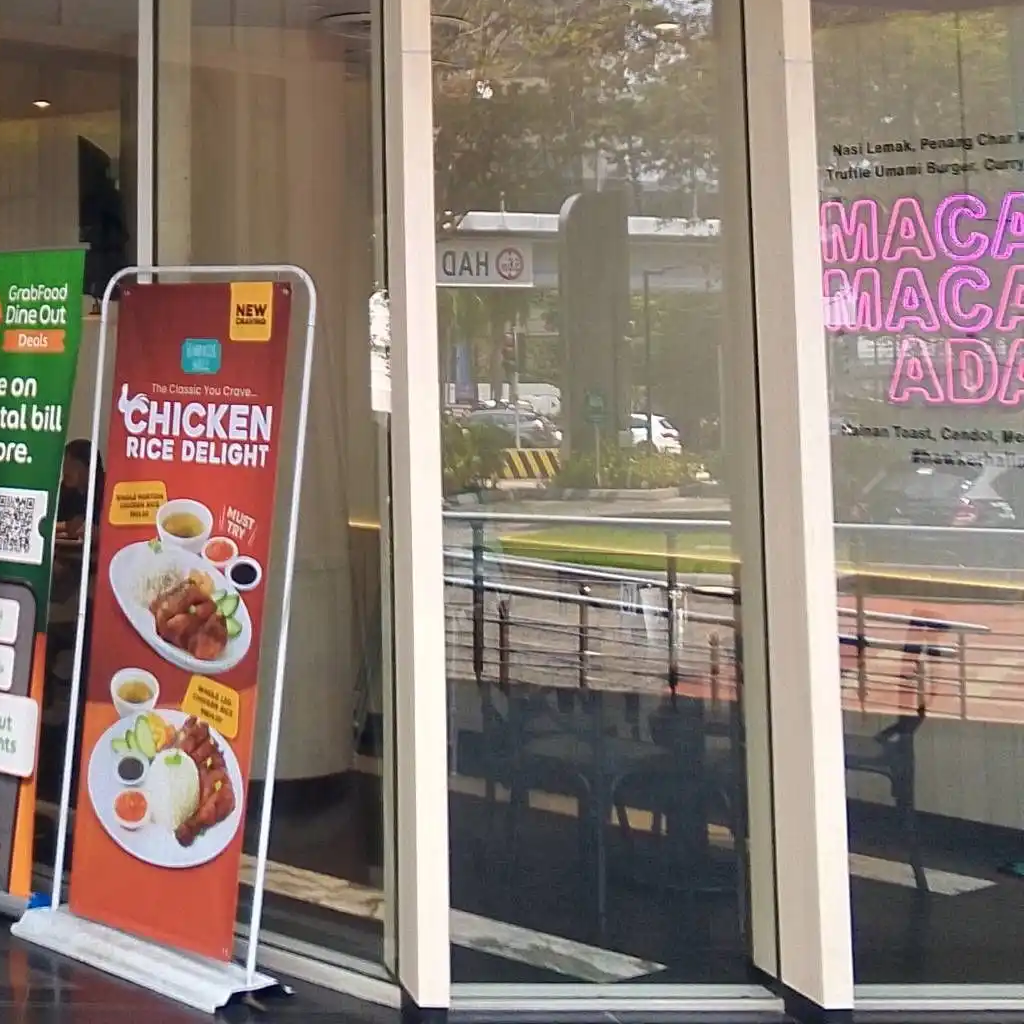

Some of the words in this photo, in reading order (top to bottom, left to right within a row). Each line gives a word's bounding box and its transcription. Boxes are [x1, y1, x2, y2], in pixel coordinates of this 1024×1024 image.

[833, 143, 864, 157] Nasi
[920, 136, 974, 151] Penang
[977, 132, 1014, 147] Char
[875, 163, 923, 178] Umami
[819, 191, 1024, 264] MACA
[8, 283, 68, 302] GrabFood
[823, 264, 1024, 332] MACA
[5, 305, 37, 325] Dine
[39, 304, 67, 325] Out
[236, 303, 268, 317] NEW
[18, 333, 48, 348] Deals
[10, 377, 37, 397] on
[152, 383, 167, 394] The
[169, 383, 202, 395] Classic
[204, 385, 222, 395] You
[31, 404, 62, 432] bill
[123, 398, 273, 442] CHICKEN
[126, 436, 175, 461] RICE
[181, 439, 270, 468] DELIGHT
[226, 506, 256, 530] MUST
[227, 520, 247, 538] TRY
